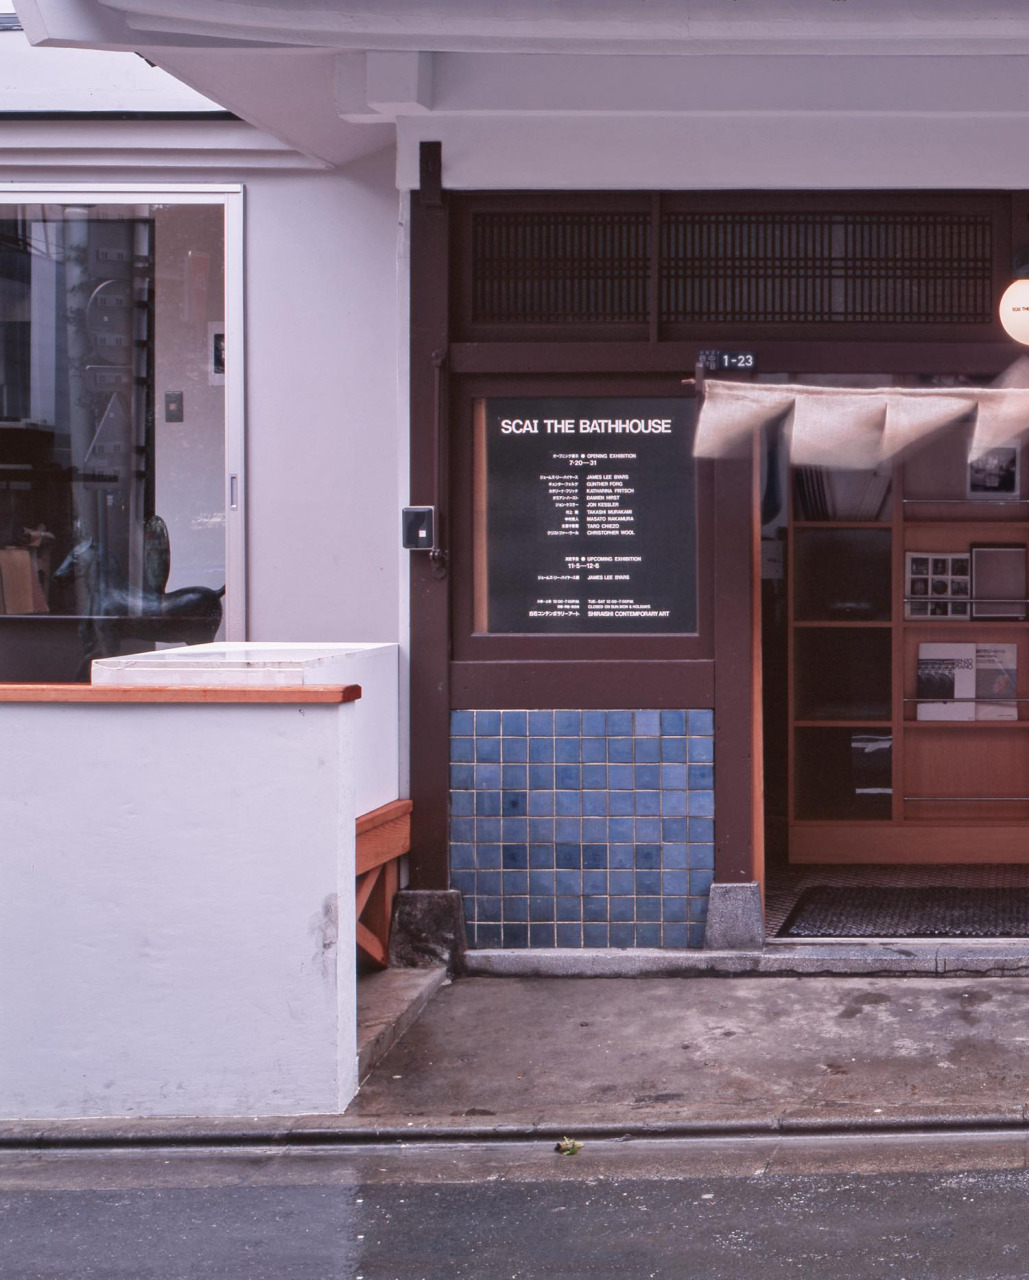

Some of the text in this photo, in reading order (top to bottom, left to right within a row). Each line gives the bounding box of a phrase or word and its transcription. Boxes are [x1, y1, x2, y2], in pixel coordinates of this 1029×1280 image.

[722, 354, 754, 367] 1-23
[501, 419, 672, 434] SCAI THE BATHHOUSE
